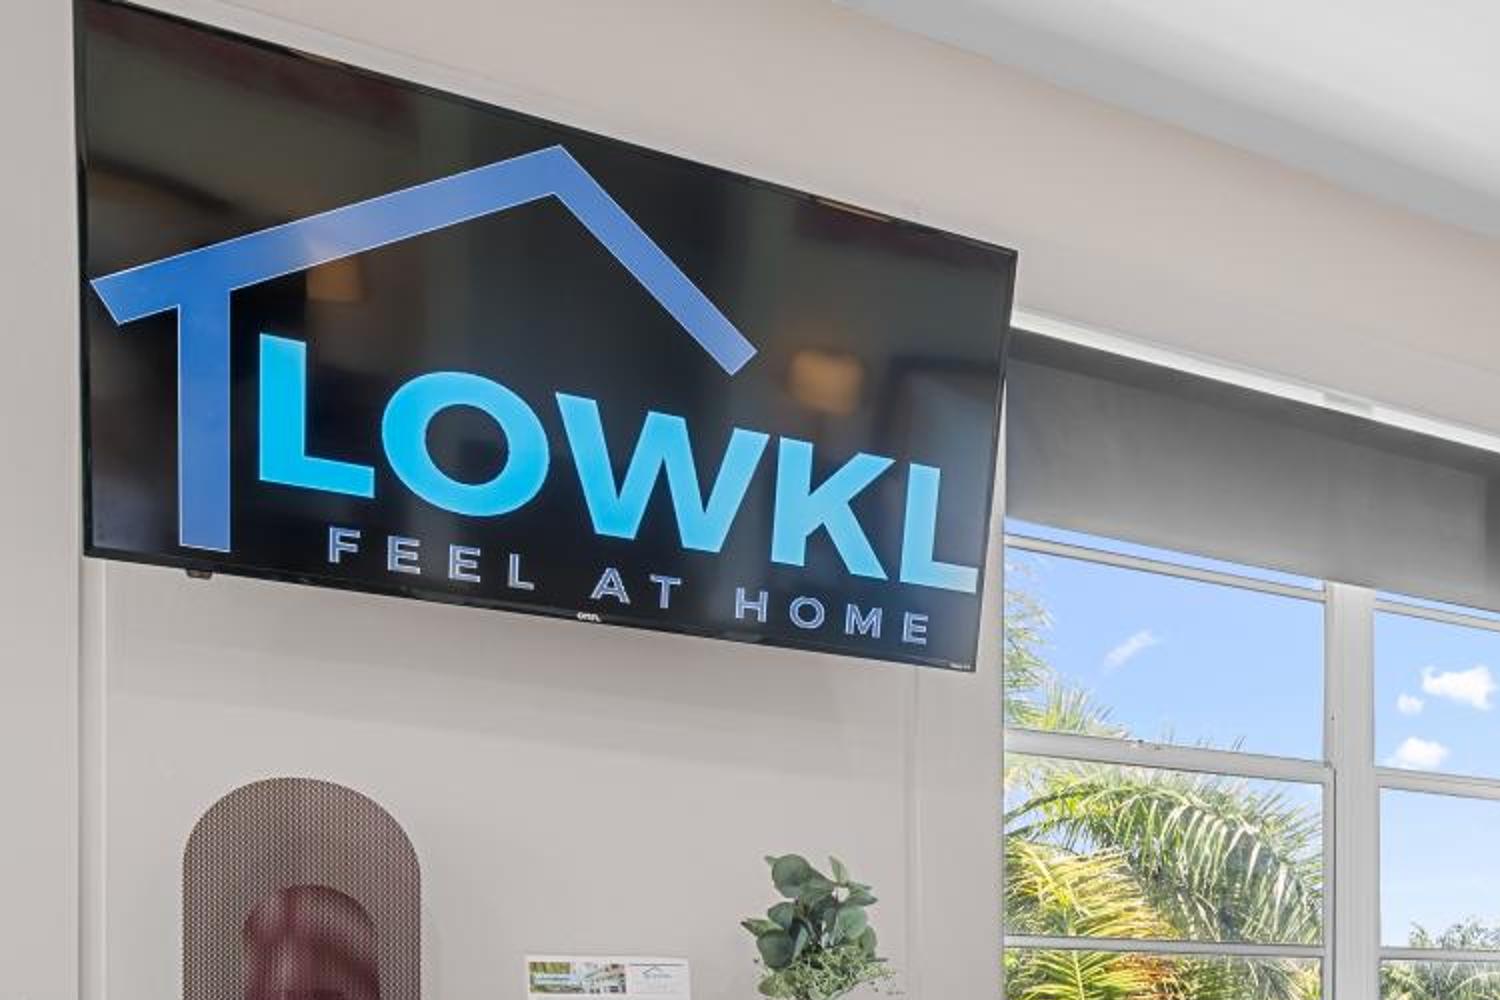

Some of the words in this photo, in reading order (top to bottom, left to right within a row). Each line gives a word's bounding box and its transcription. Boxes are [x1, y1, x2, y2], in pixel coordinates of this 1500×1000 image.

[259, 333, 978, 595] LOWKL
[328, 526, 536, 590] FEEL
[590, 567, 682, 609] AT
[734, 586, 930, 646] HOME
